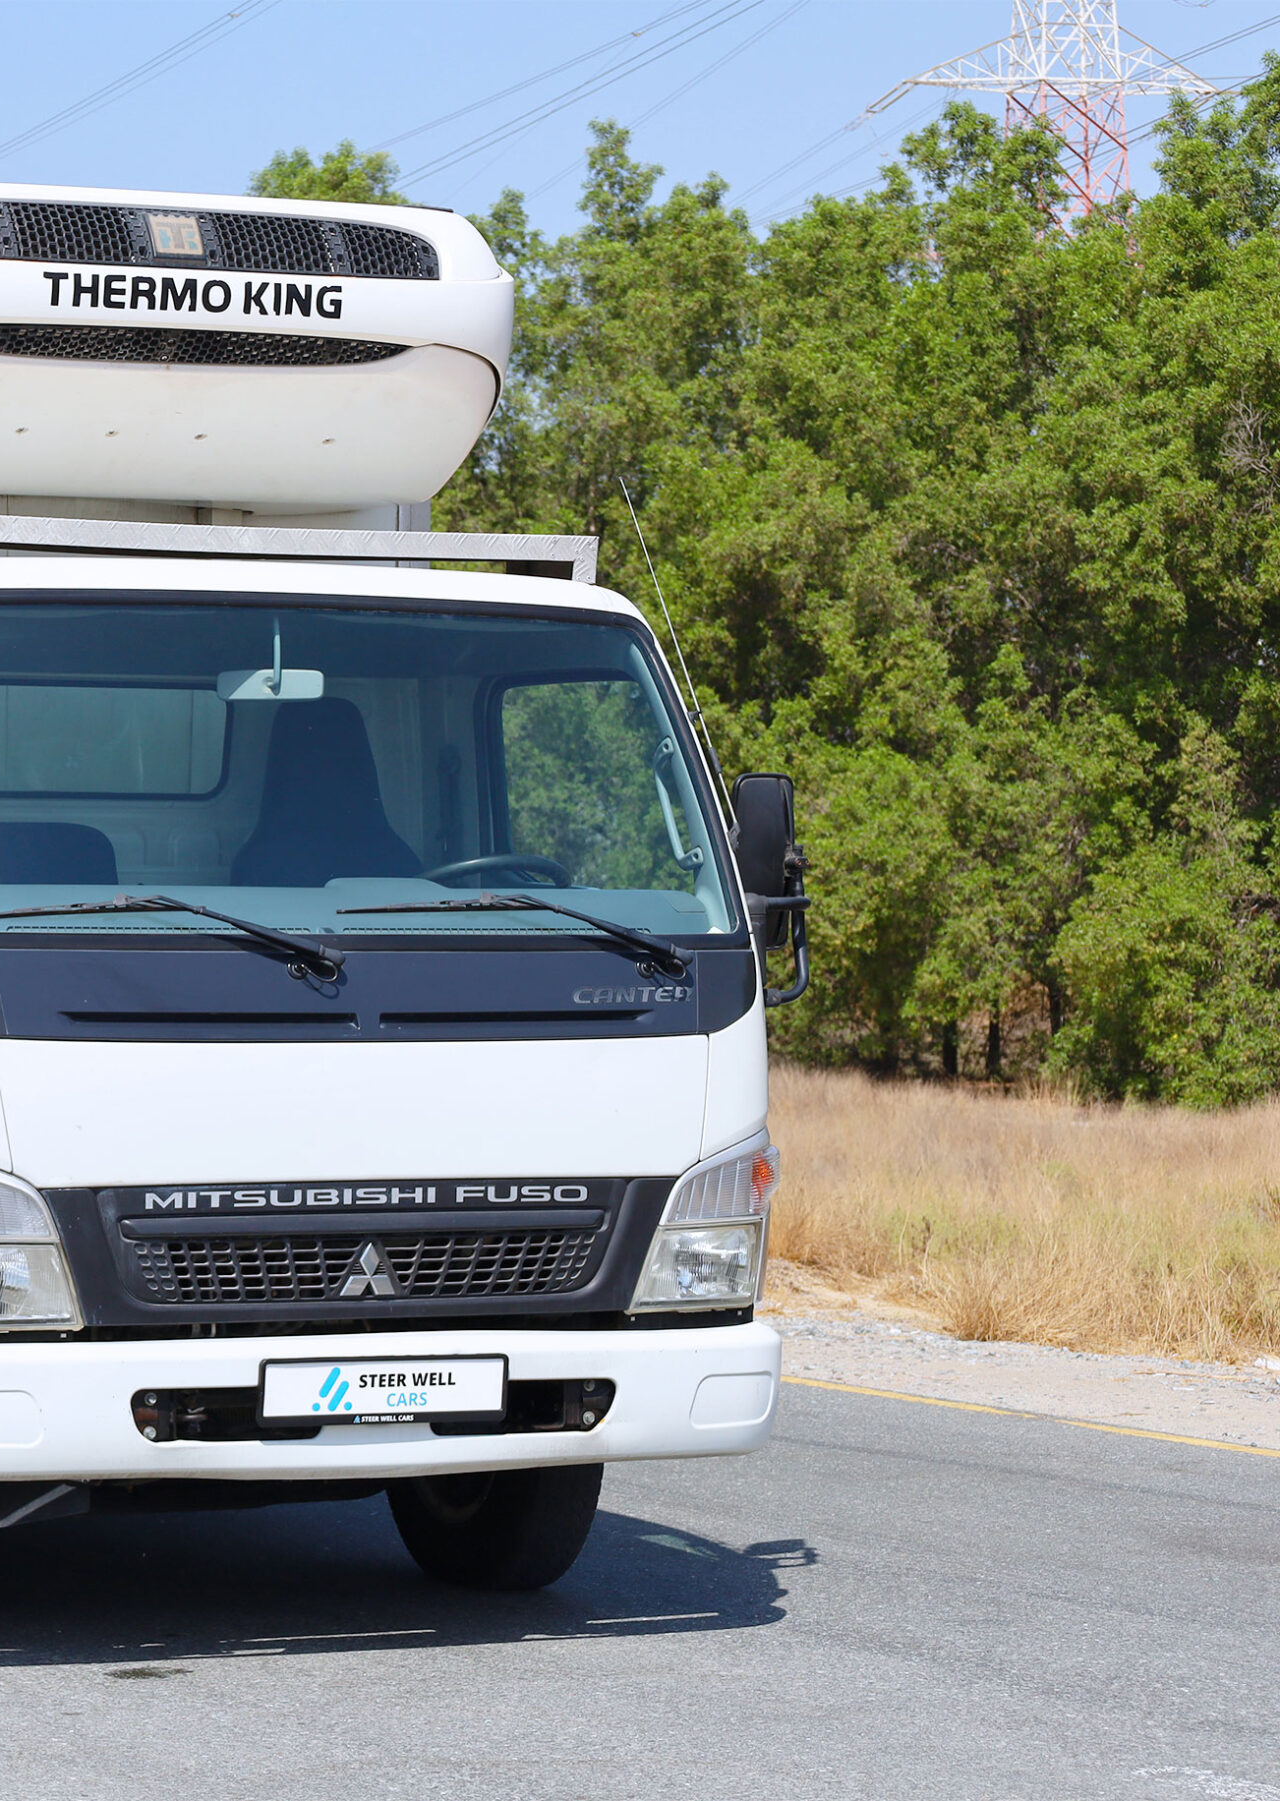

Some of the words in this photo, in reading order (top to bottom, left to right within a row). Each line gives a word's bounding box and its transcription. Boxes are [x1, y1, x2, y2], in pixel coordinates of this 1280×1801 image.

[43, 271, 232, 313] THERMO
[243, 281, 343, 319] KING
[572, 985, 694, 1004] CANTER
[144, 1186, 437, 1210] MITSUBISHI
[455, 1184, 589, 1203] FUSO
[358, 1373, 407, 1389] STEER
[412, 1371, 456, 1387] WELL
[386, 1391, 428, 1407] CARS
[361, 1415, 380, 1423] STEER
[398, 1414, 414, 1422] CARS
